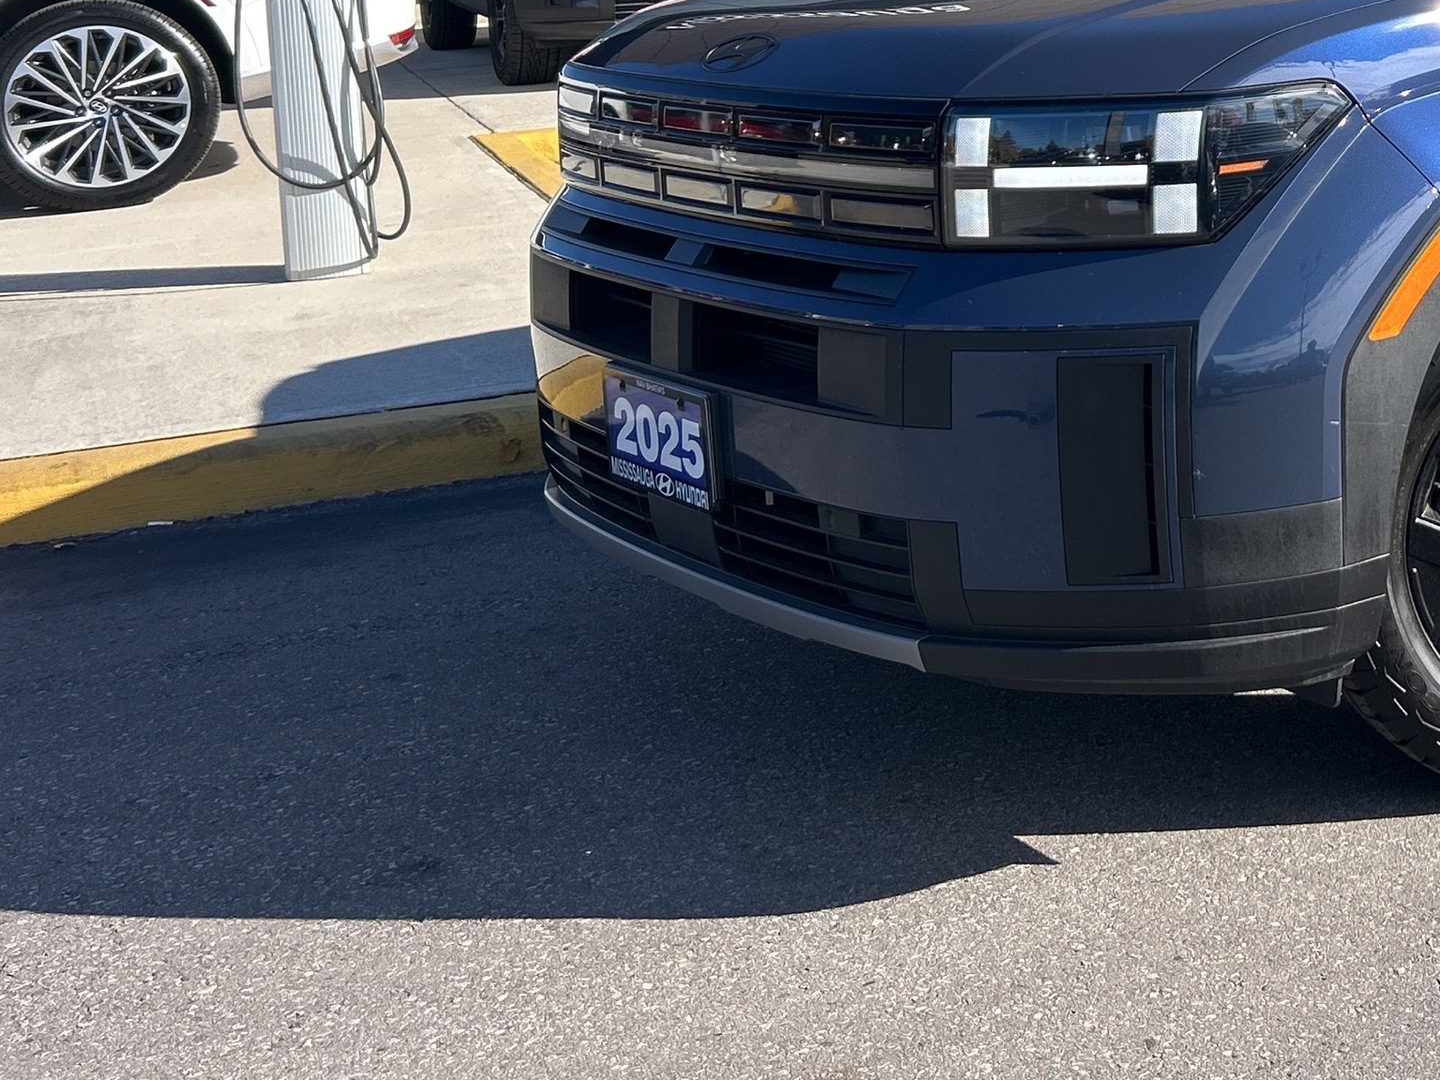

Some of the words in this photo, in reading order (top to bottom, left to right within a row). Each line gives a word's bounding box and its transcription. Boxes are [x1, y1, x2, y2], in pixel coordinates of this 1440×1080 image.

[614, 396, 705, 479] 2025
[611, 455, 656, 490] MISSISSAUGA
[675, 480, 710, 510] HYUNDAI
